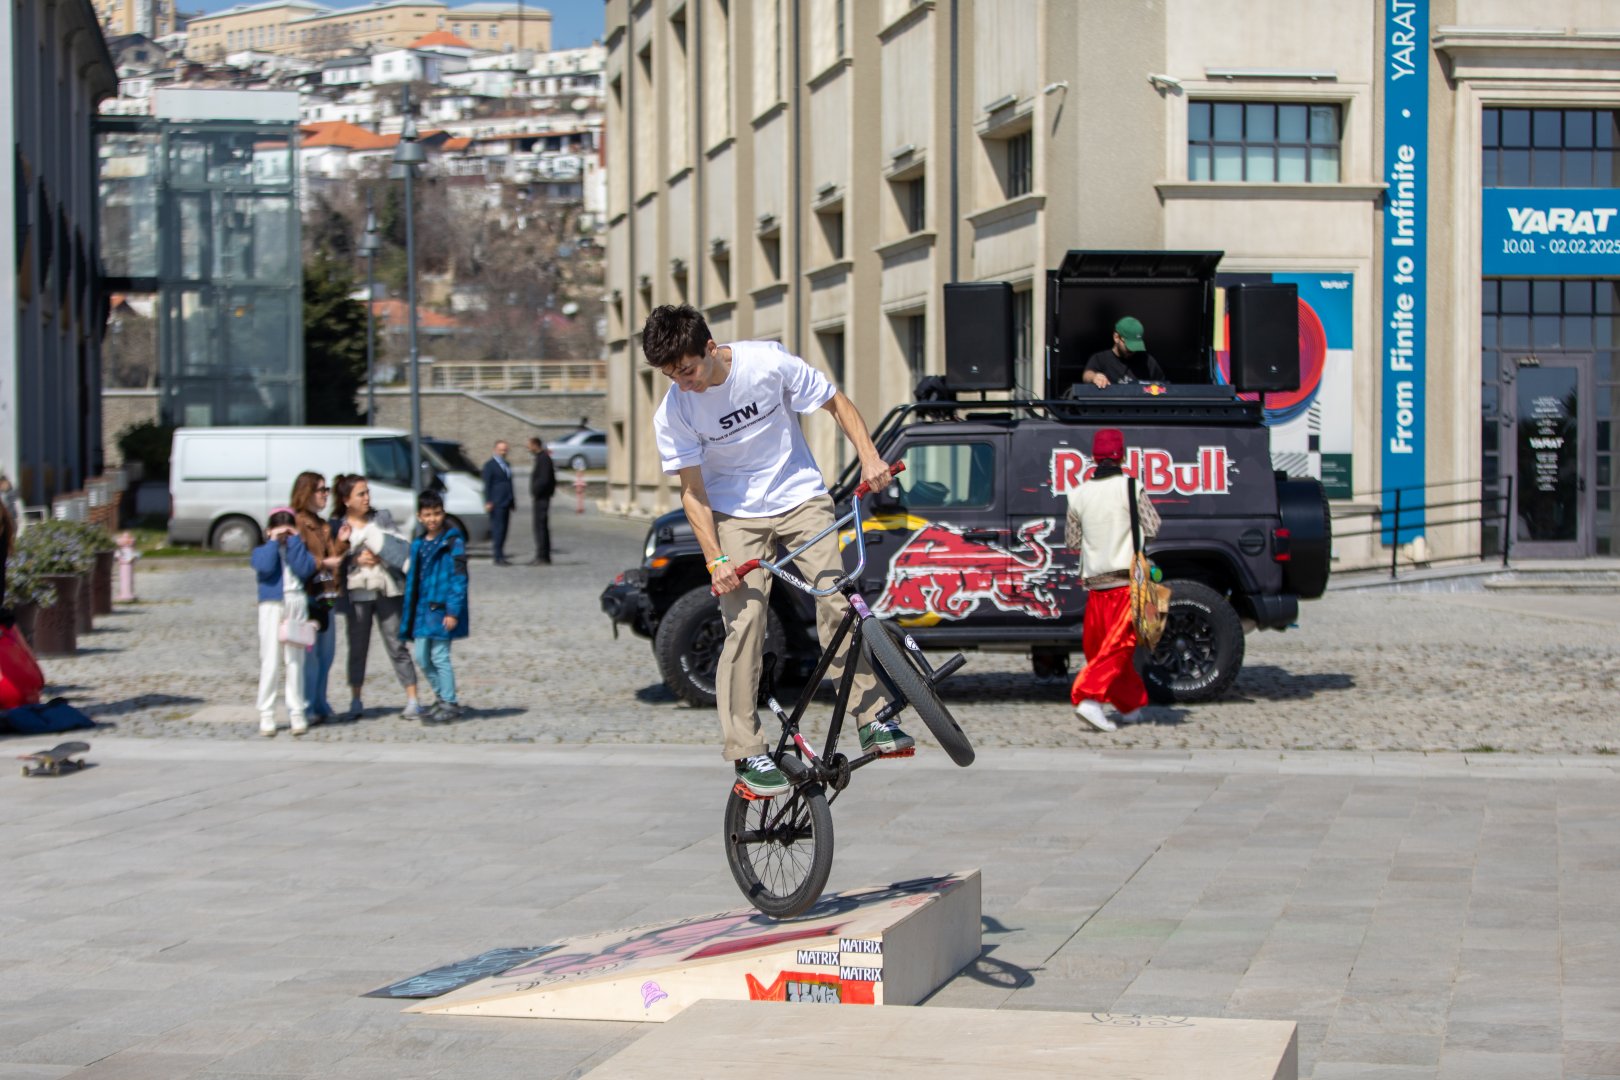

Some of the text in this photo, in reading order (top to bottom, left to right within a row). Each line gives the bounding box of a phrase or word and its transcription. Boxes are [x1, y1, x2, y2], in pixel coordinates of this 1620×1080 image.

[1390, 0, 1416, 454] From Finite to Infinite YARAT
[1507, 207, 1618, 235] YARAT
[719, 401, 759, 430] STW
[1053, 448, 1142, 495] Rd
[798, 950, 839, 965] MATRIX
[840, 938, 881, 954] MATRIX
[840, 966, 882, 982] MATRIX
